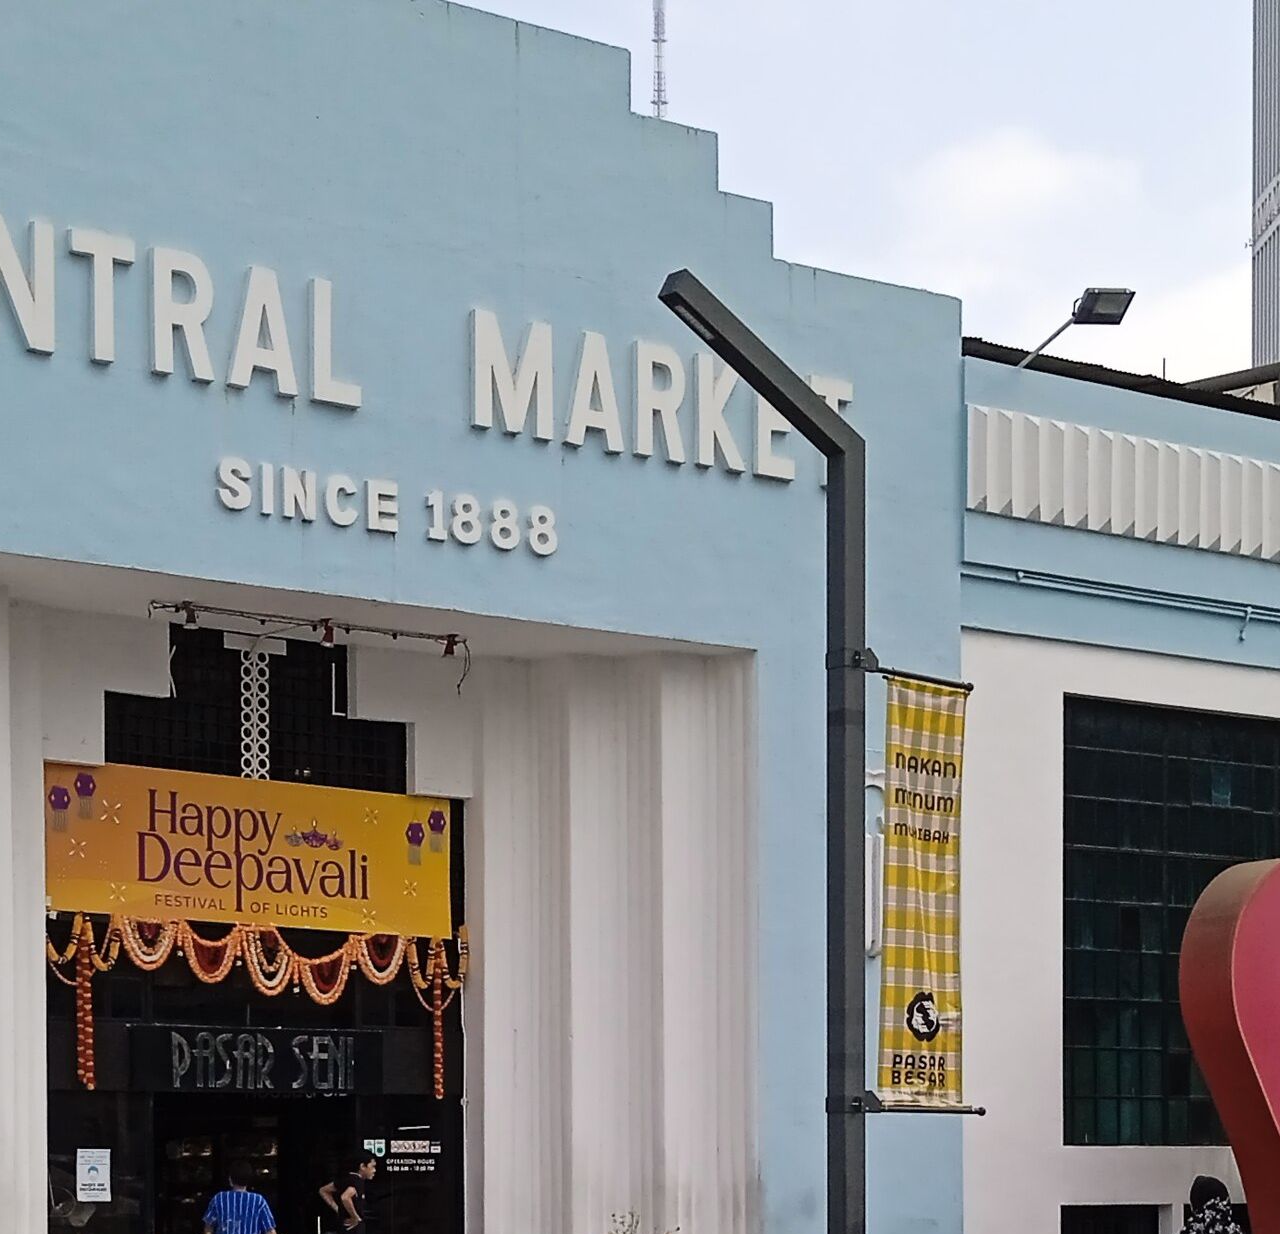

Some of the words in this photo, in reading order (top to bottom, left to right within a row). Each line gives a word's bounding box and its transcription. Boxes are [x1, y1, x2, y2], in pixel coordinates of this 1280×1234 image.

[216, 457, 400, 535] SINCE
[424, 489, 560, 556] 1888
[147, 789, 283, 856] Happy
[136, 831, 369, 912] Deepavali
[154, 893, 226, 911] FESTIVAL
[250, 902, 270, 914] OF
[276, 903, 328, 919] LIGHTS
[171, 1031, 274, 1089] PASAR
[291, 1034, 355, 1090] SENI
[892, 1070, 946, 1088] BESAR
[893, 1054, 946, 1071] PASAR
